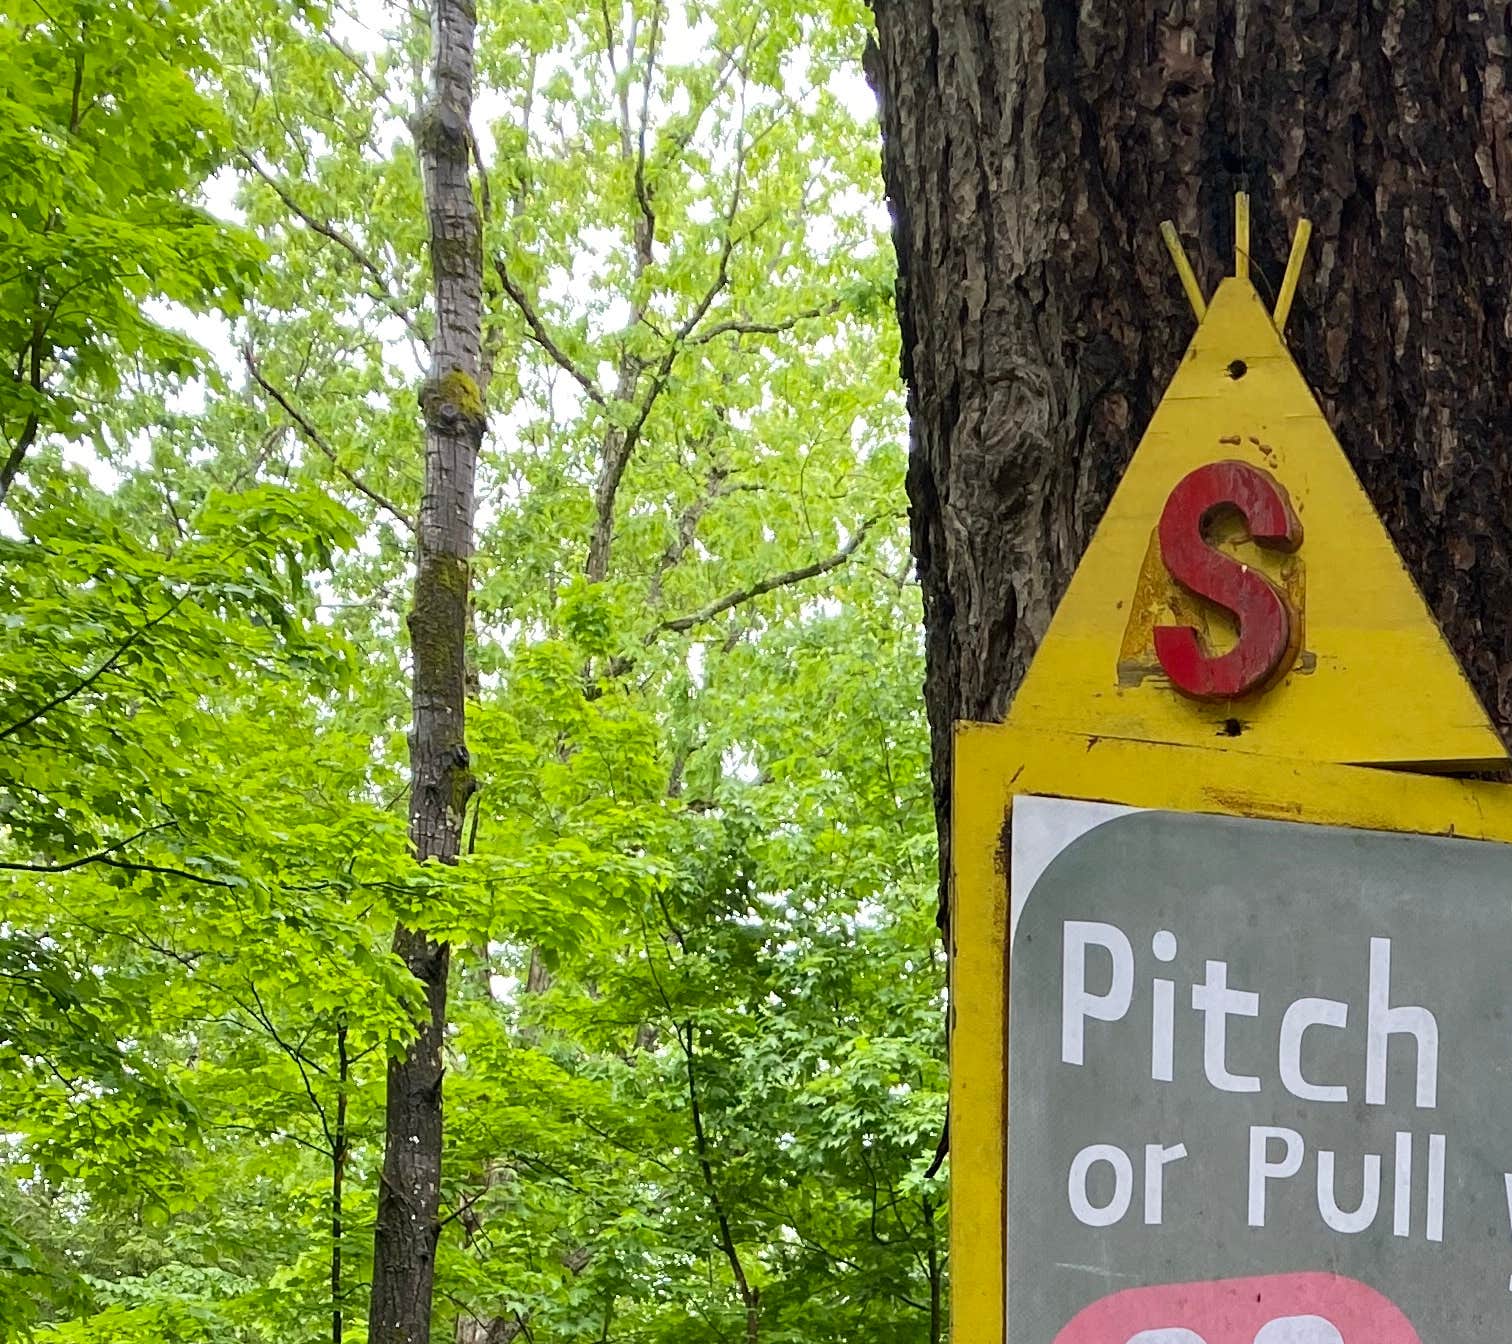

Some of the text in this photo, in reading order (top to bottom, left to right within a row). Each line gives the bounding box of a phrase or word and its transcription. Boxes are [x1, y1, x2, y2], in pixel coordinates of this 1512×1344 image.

[1154, 459, 1303, 703] S
[1061, 920, 1439, 1109] Pitch
[1067, 1142, 1188, 1227] or
[1247, 1126, 1446, 1243] Pull
